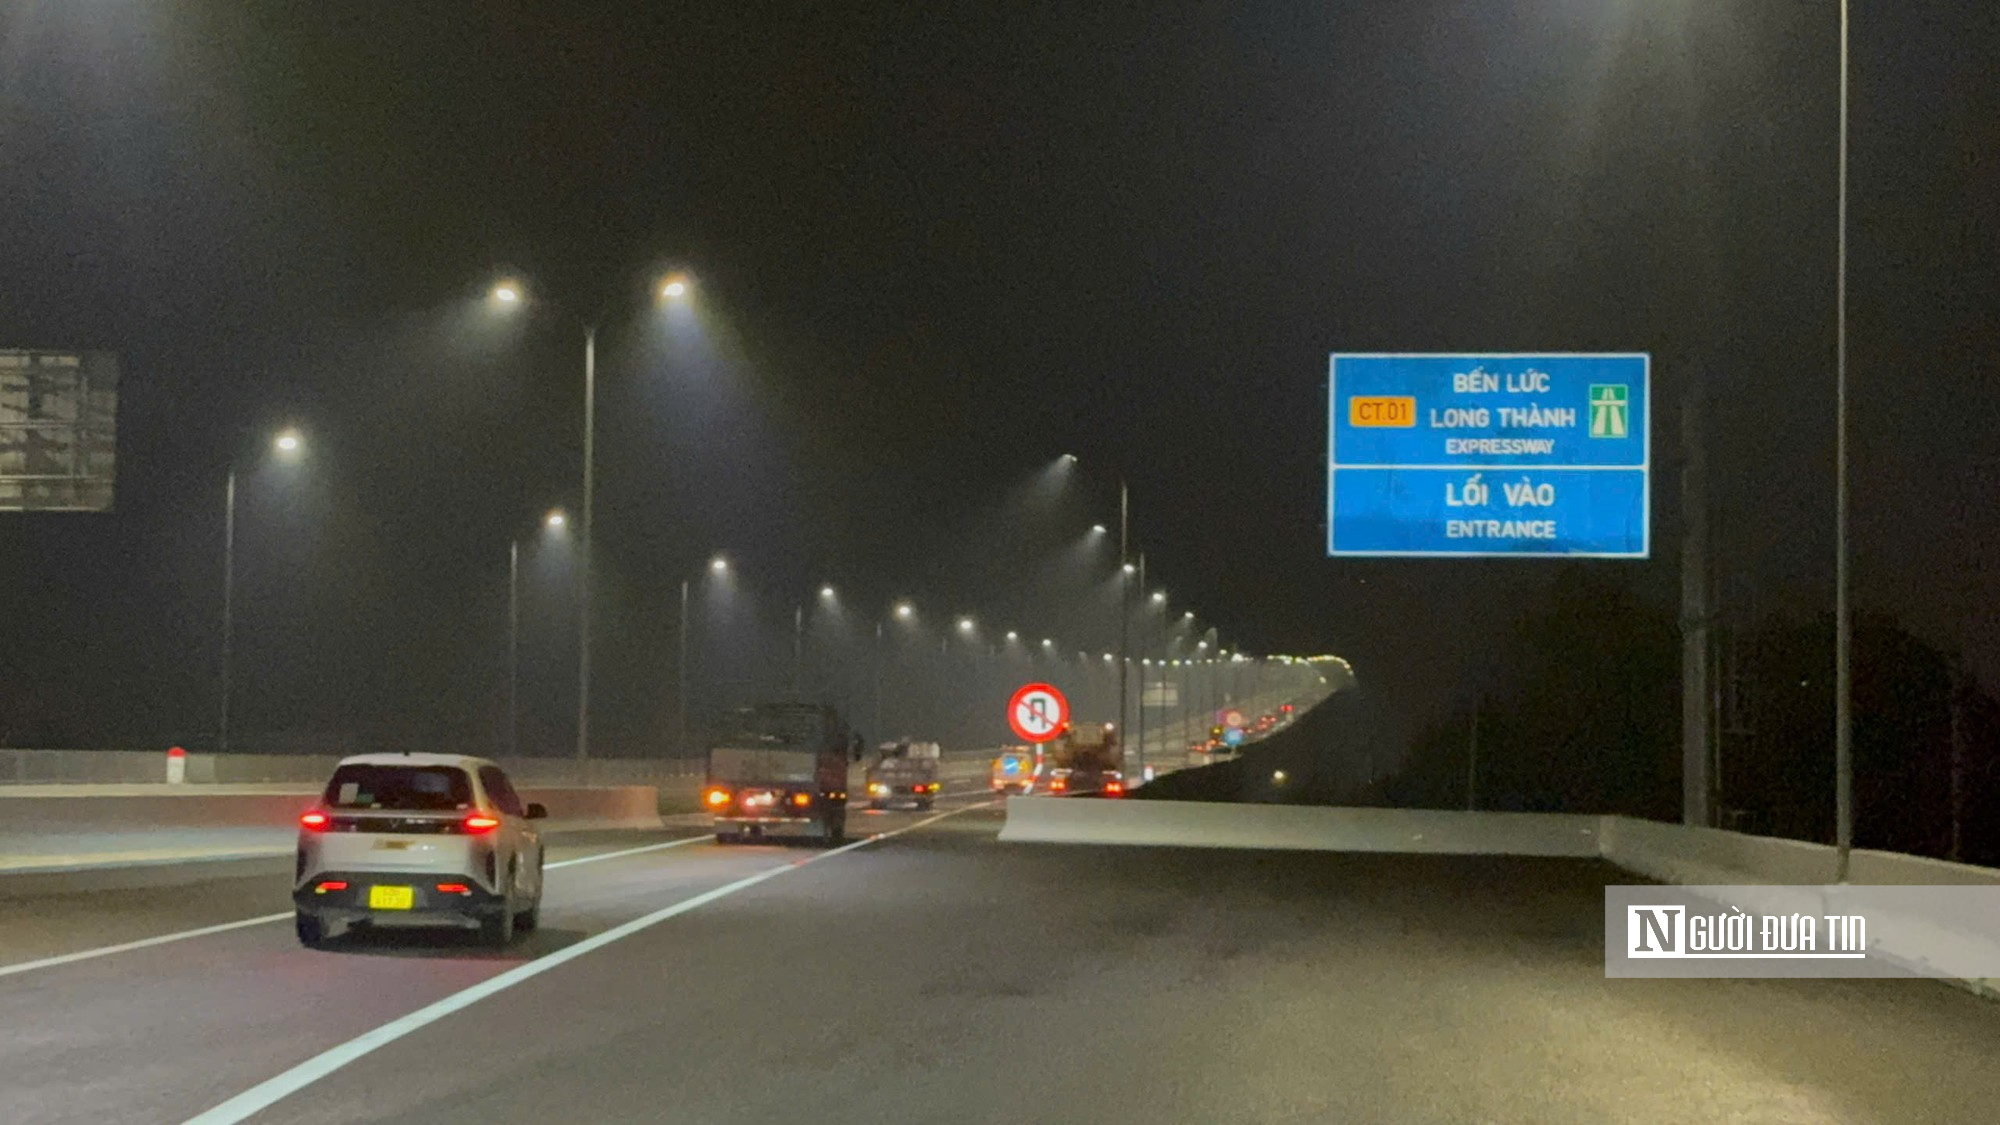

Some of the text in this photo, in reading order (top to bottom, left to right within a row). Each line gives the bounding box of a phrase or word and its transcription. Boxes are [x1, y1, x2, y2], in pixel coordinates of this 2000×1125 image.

[1453, 366, 1550, 393] BẾN LỨC
[1358, 402, 1408, 421] CT.01
[1431, 403, 1576, 427] LONG THÀNH
[1446, 439, 1554, 454] EXPRESSWAY
[1446, 474, 1554, 506] LỐI VÀO
[1446, 520, 1556, 538] ENTRANCE
